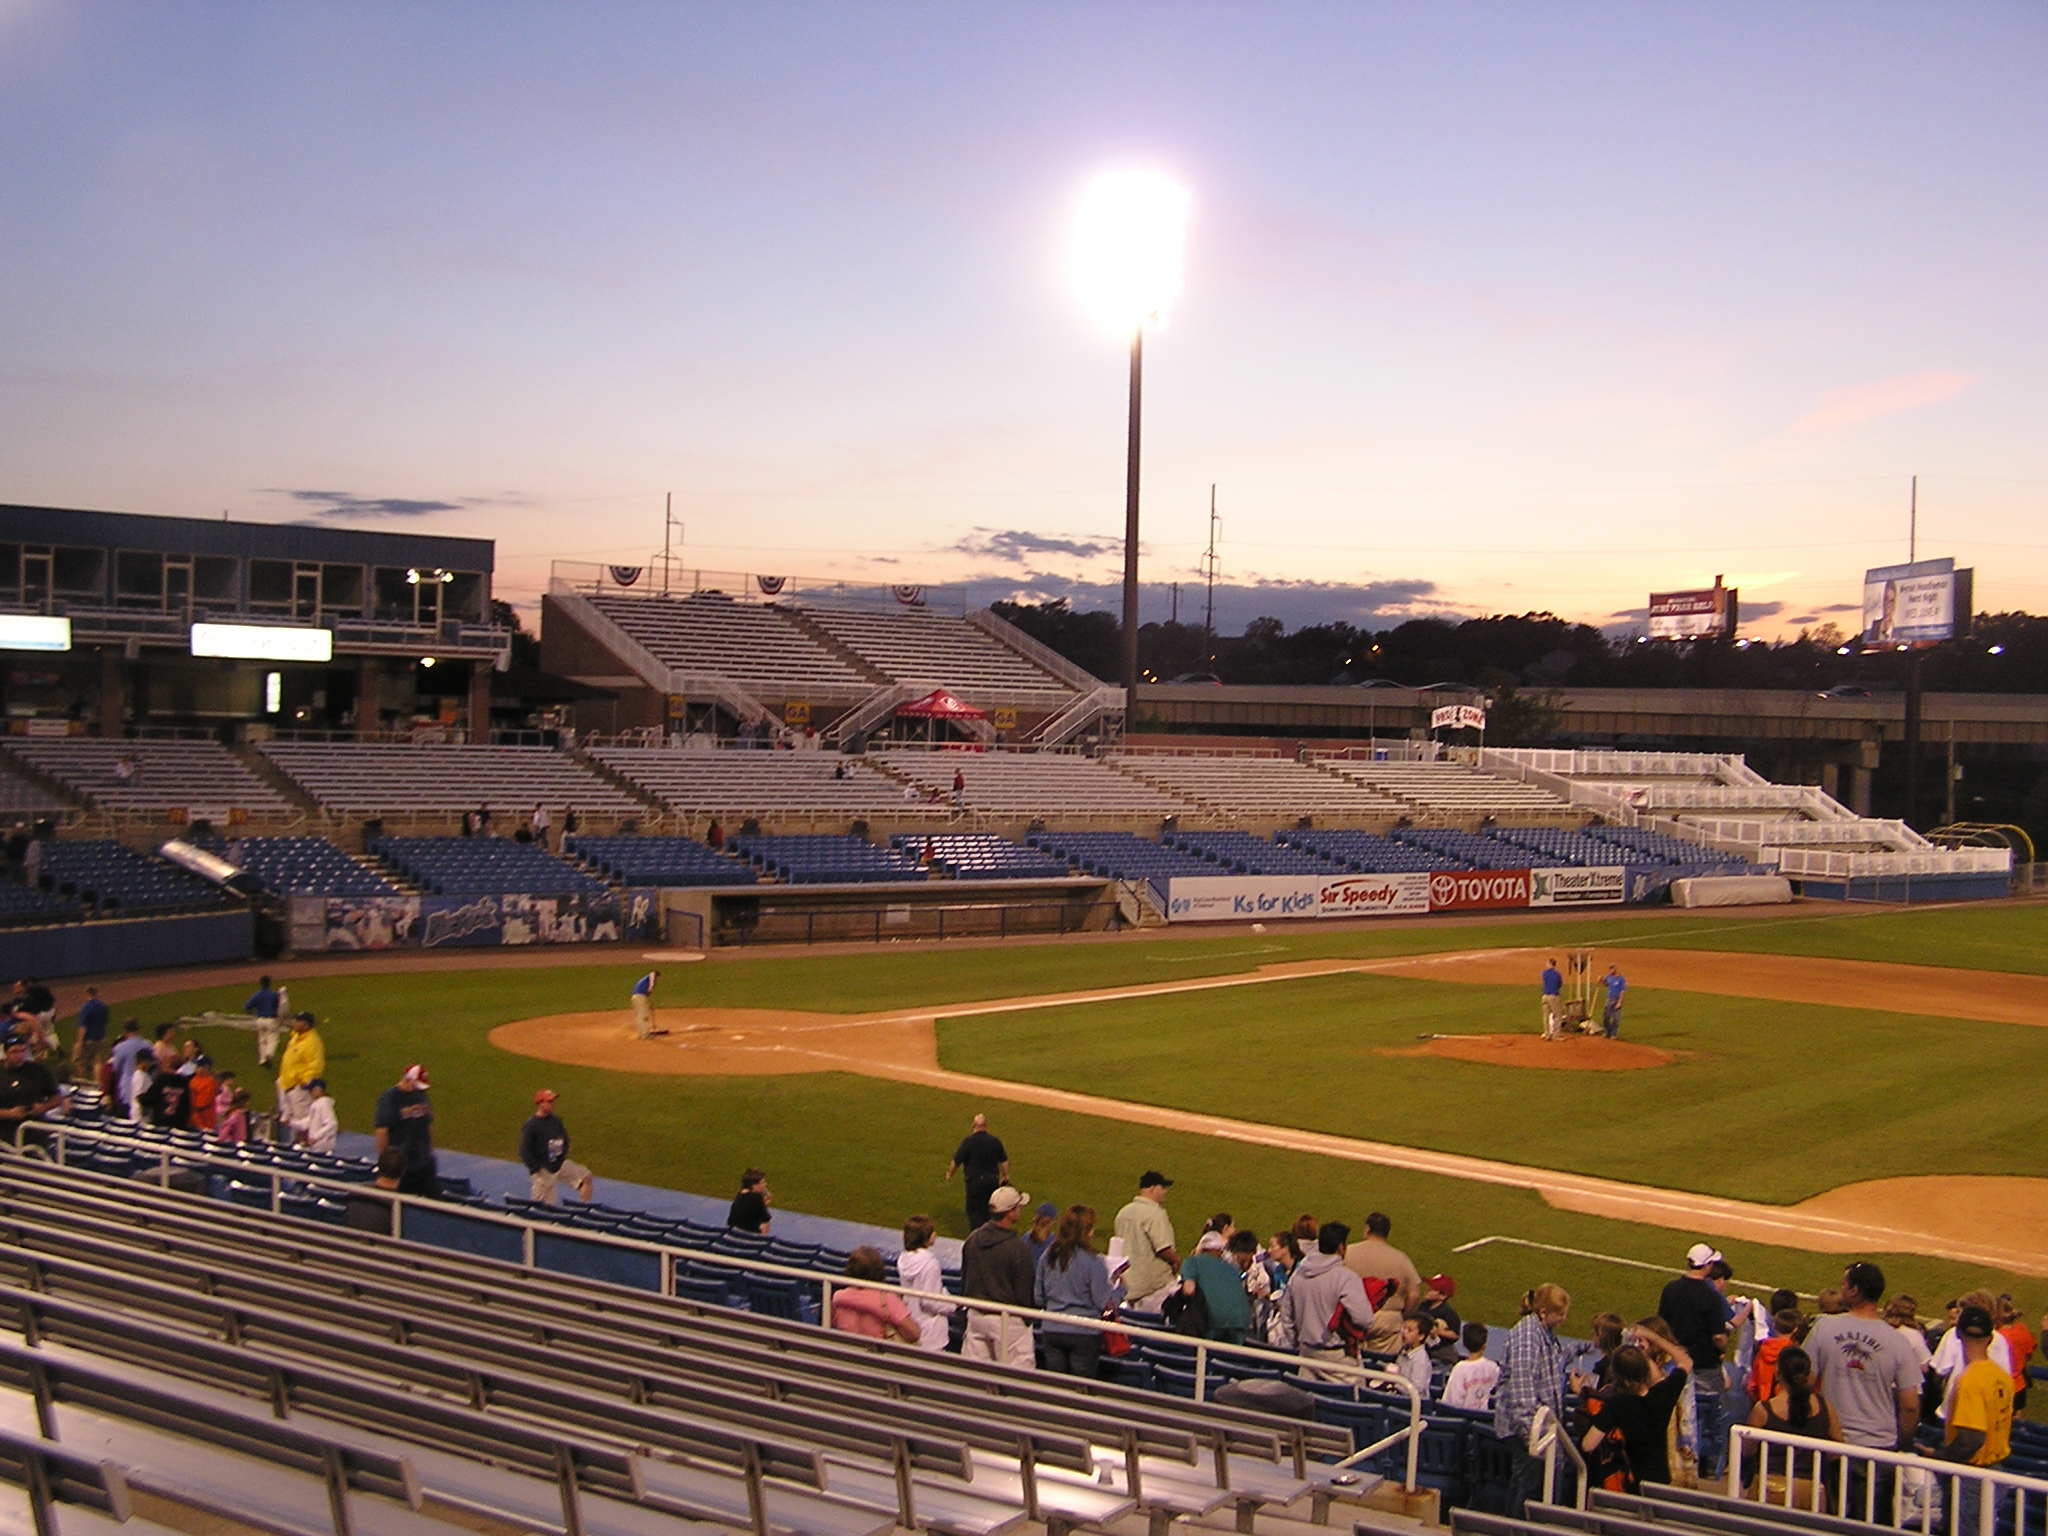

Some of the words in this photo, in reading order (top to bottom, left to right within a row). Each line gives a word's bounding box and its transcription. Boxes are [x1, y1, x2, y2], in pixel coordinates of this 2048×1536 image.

[1321, 887, 1339, 904] Sir
[1342, 883, 1399, 906] Speedy
[1458, 877, 1527, 902] TOYOTA
[1233, 894, 1254, 913] Ks
[1257, 893, 1279, 911] for
[1281, 890, 1314, 913] Kids
[1834, 1331, 1884, 1354] MALIBU
